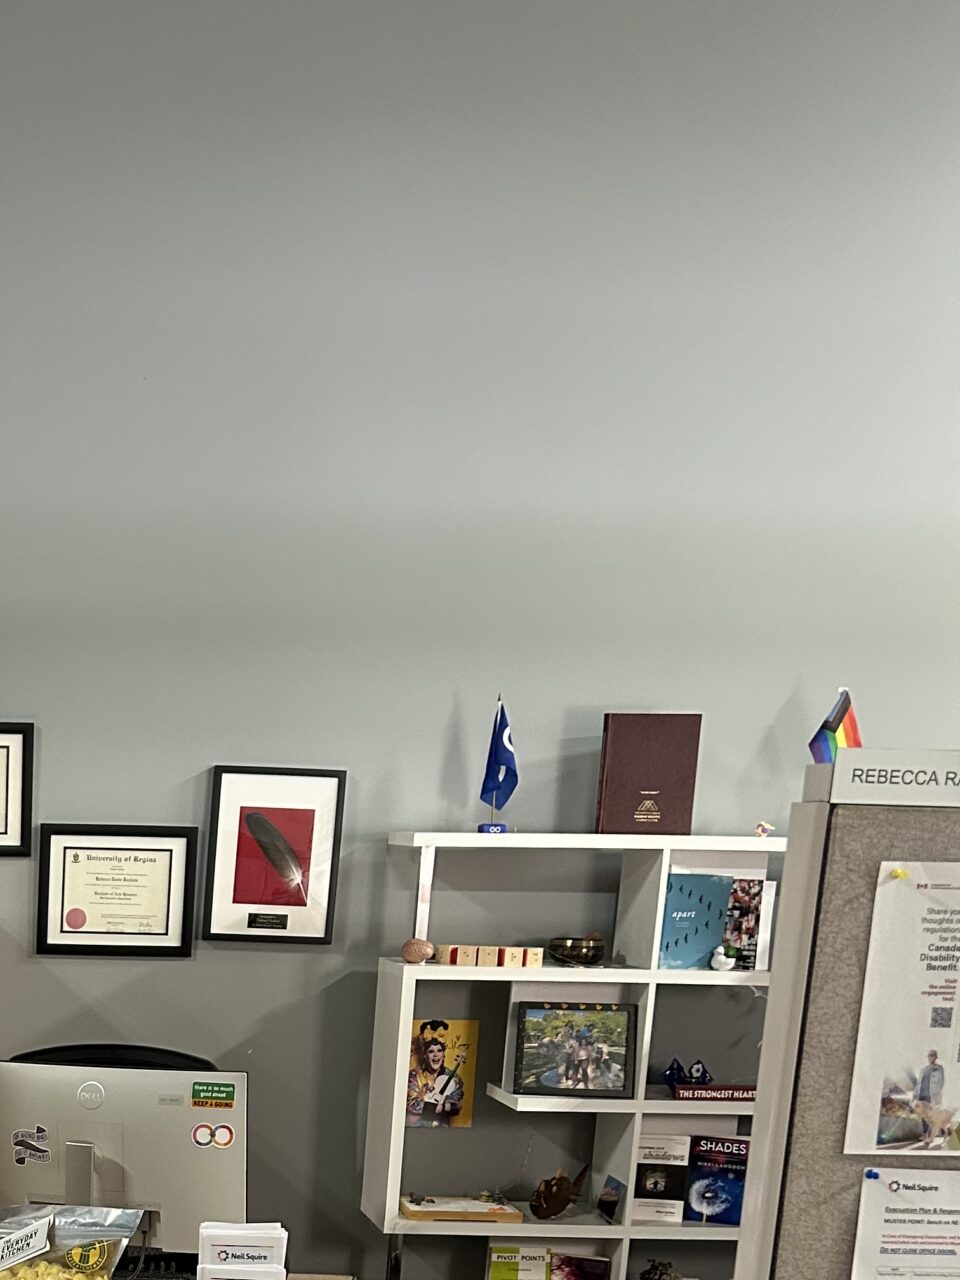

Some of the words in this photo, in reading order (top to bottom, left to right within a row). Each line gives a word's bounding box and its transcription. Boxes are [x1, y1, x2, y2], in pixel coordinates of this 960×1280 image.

[851, 768, 939, 786] REBECCA
[944, 771, 960, 787] R
[86, 854, 122, 864] University
[124, 855, 132, 863] of
[133, 855, 157, 865] Regina
[671, 910, 696, 920] apart
[926, 907, 948, 915] Share
[920, 916, 954, 925] thoughts
[927, 943, 960, 952] Canada
[919, 953, 960, 963] Disability
[679, 1090, 693, 1098] THE
[693, 1090, 733, 1099] STRONGEST
[733, 1090, 757, 1099] HEART
[700, 1140, 746, 1154] SHADES
[902, 1183, 916, 1191] Neil
[916, 1184, 939, 1192] Squire
[2, 1229, 39, 1254] EVERYDAY
[0, 1242, 31, 1261] KITCHEN
[230, 1252, 245, 1260] Neil
[245, 1253, 268, 1262] Squire
